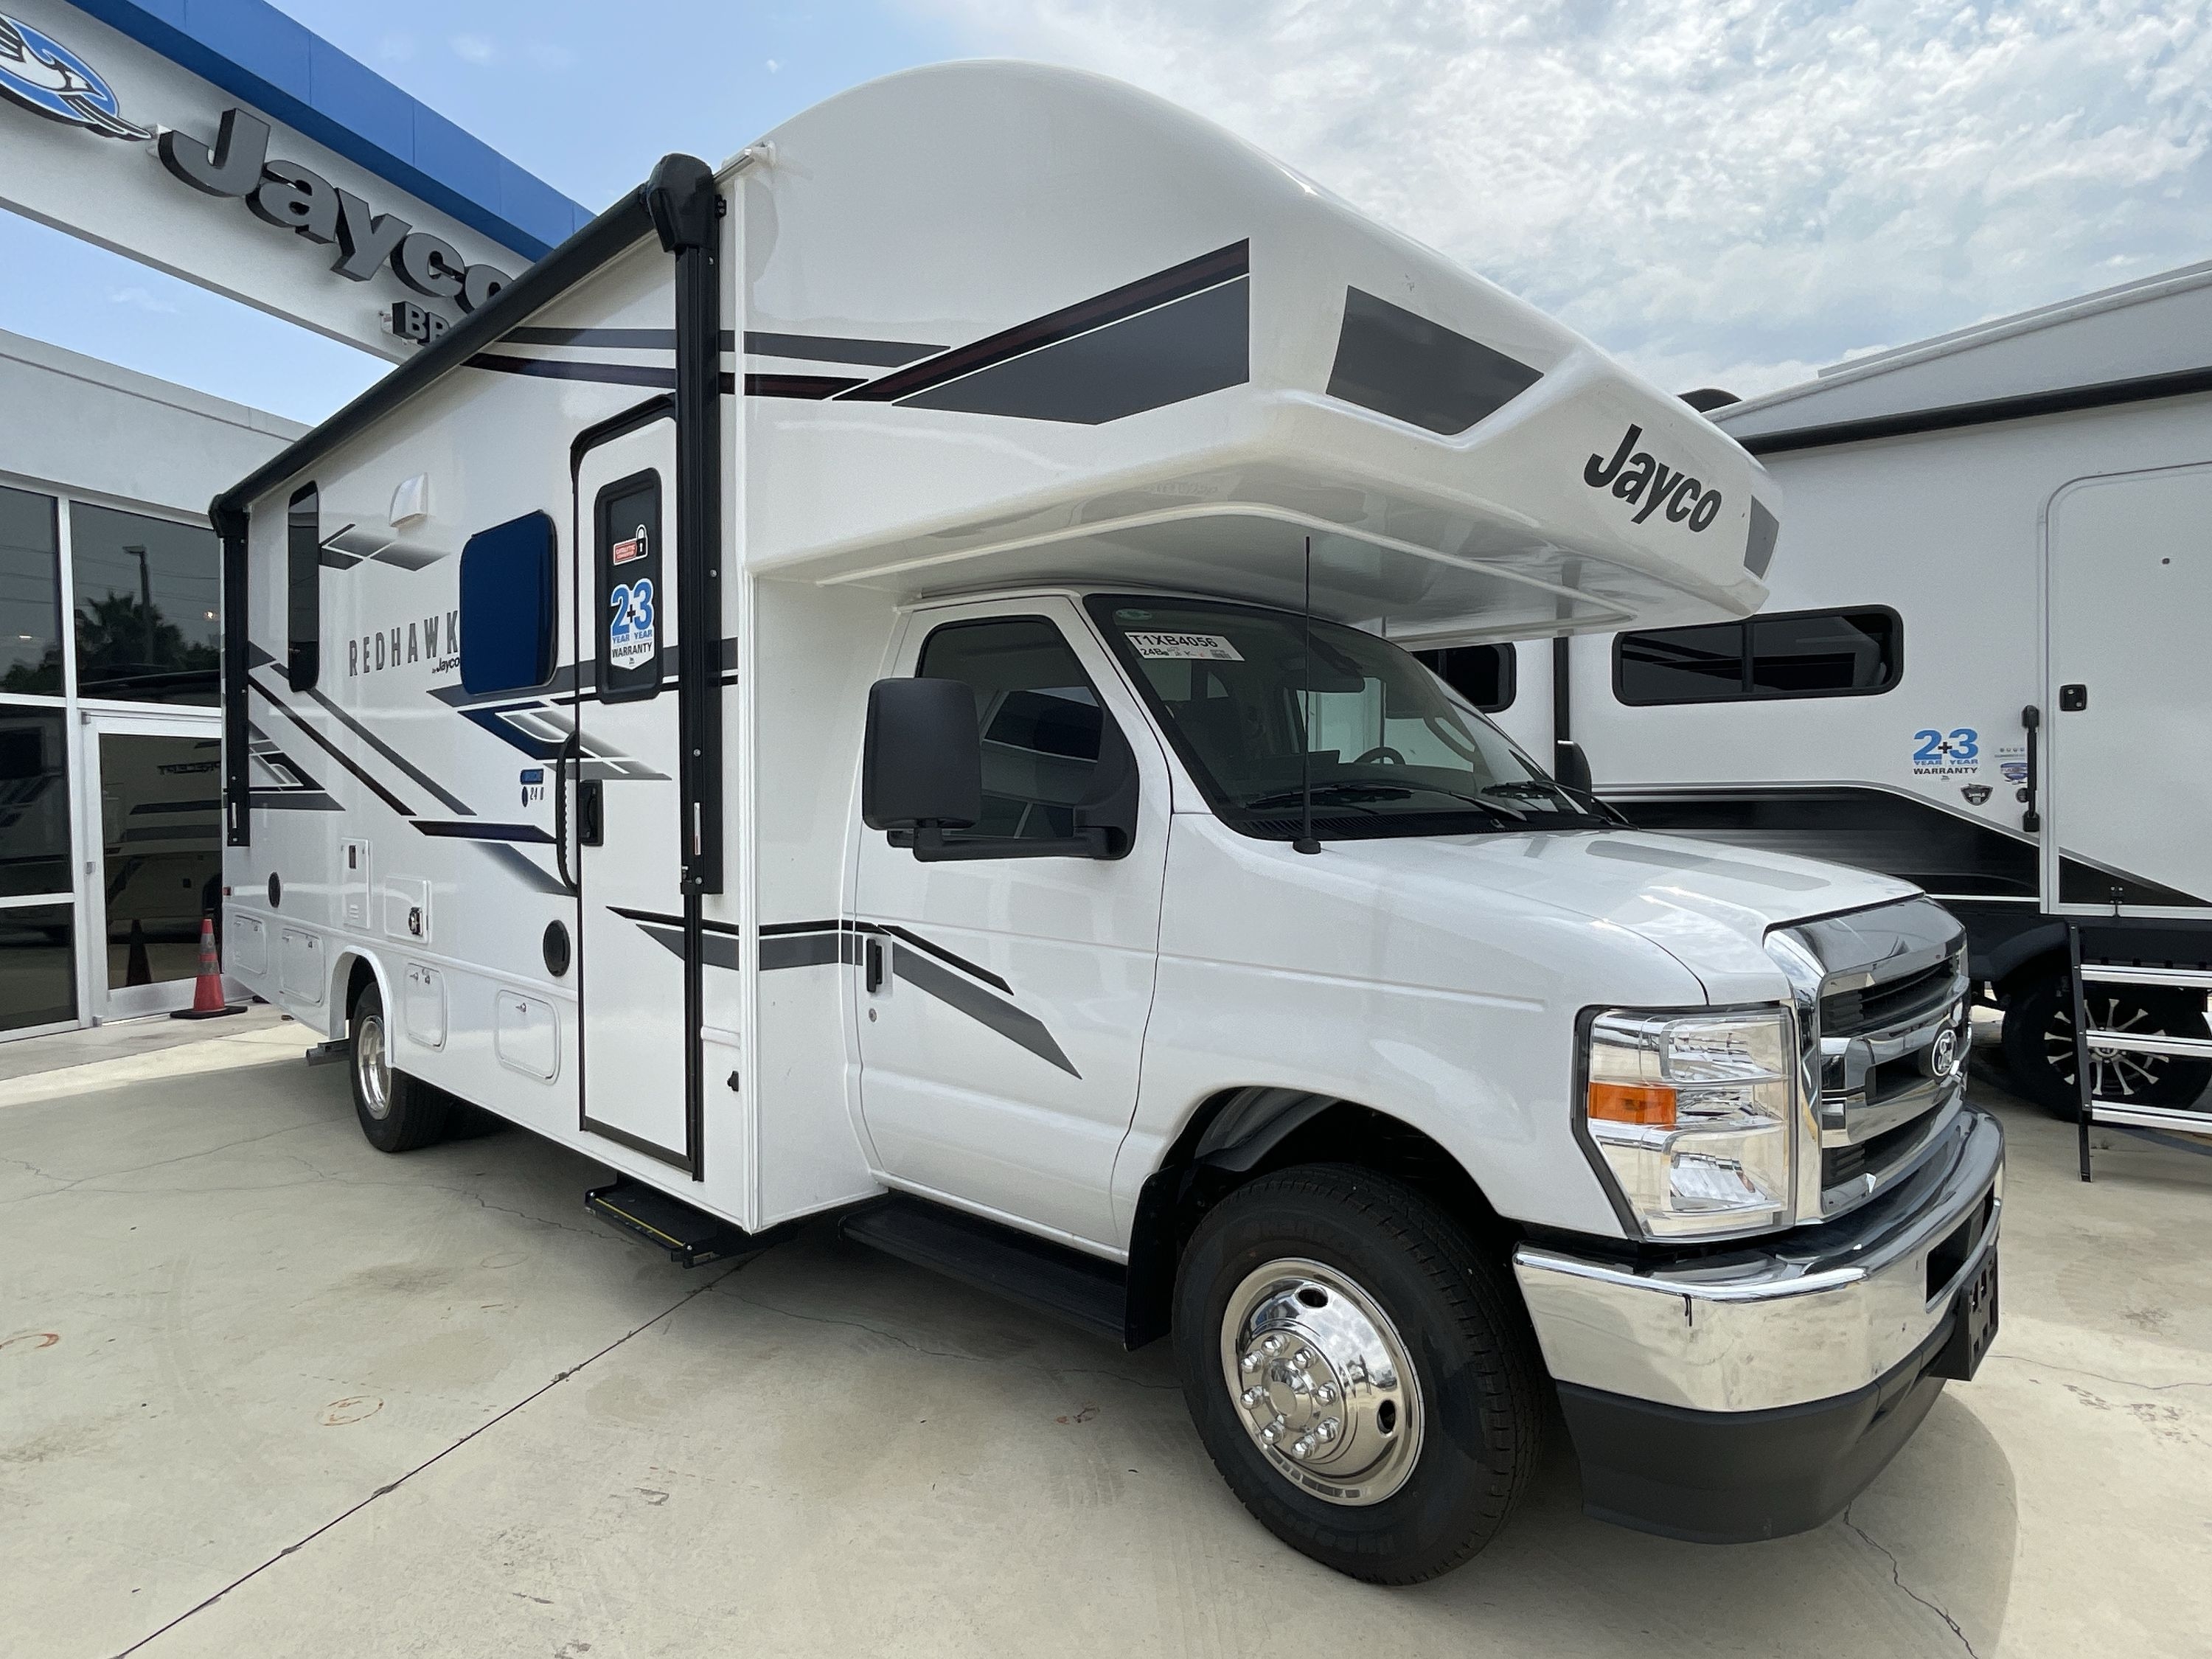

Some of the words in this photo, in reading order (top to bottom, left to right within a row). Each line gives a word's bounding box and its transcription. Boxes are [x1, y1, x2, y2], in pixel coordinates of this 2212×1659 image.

[158, 108, 516, 314] Jayco
[1584, 423, 1722, 532] Jayco
[349, 610, 459, 677] REDHAWK
[613, 634, 630, 644] YEAR
[633, 630, 653, 639] YEAR
[1129, 635, 1218, 647] T1XB4056
[612, 642, 653, 658] WARRANTY
[436, 657, 460, 674] Jayco
[1913, 767, 1978, 775] WARRANTY
